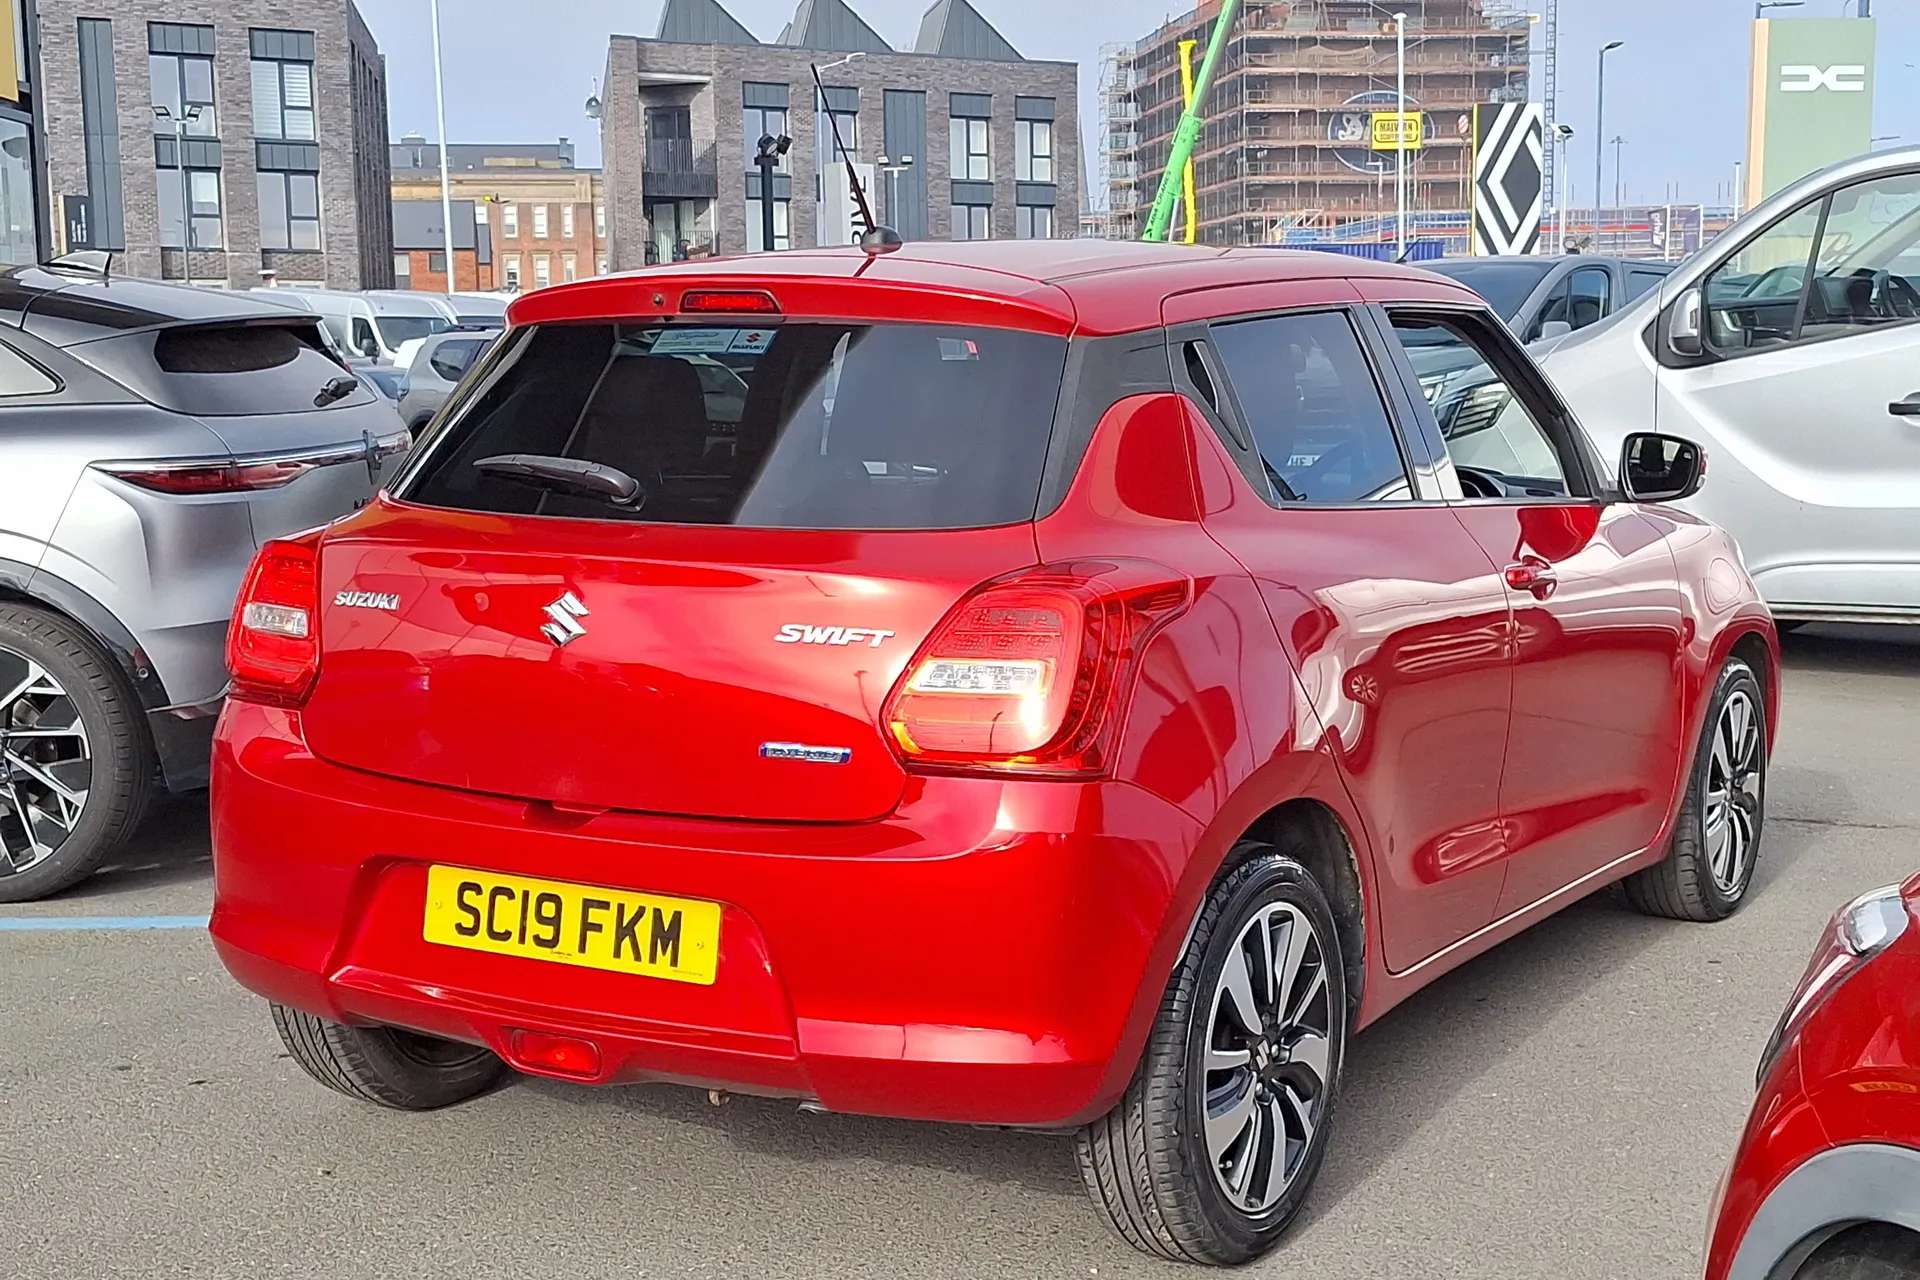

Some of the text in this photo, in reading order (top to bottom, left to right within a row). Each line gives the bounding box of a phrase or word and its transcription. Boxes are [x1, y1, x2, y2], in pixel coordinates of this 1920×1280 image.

[334, 591, 400, 611] SUZUKI
[774, 623, 896, 648] SWIFT
[454, 881, 683, 968] SC19 FKM
